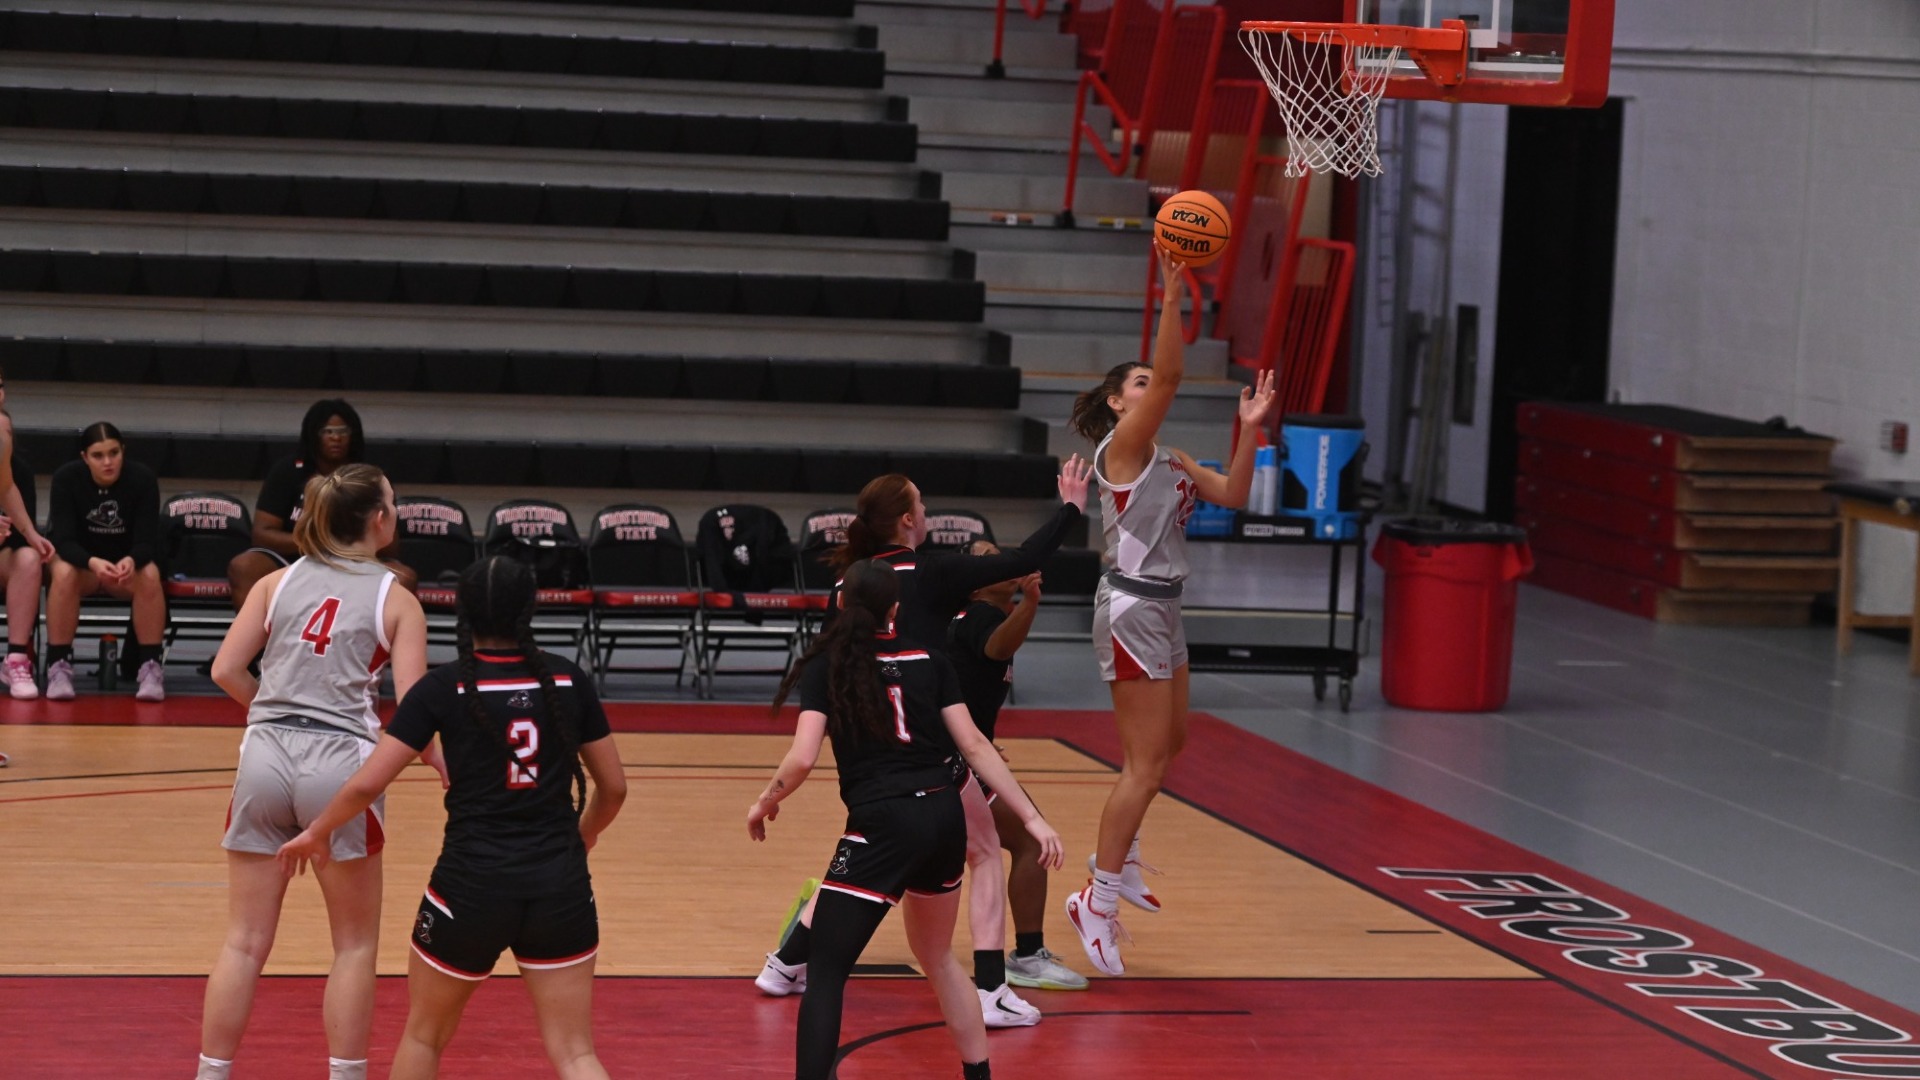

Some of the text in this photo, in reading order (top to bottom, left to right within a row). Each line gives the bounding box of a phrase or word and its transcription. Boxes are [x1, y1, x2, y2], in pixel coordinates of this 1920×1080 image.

[1171, 209, 1210, 228] NCAA
[1161, 228, 1210, 253] Wilson
[1315, 435, 1330, 510] POWERADE
[169, 498, 241, 519] FROSTBURG
[495, 505, 567, 526] FROSTBURG
[185, 514, 227, 529] STATE
[407, 519, 448, 535] STATE
[511, 522, 553, 537] STATE
[599, 510, 670, 531] FROSTBURG
[615, 526, 657, 540] STATE
[194, 585, 232, 595] BOBCA
[633, 594, 679, 605] BOBCATS
[299, 596, 342, 657] 4
[887, 684, 911, 742] 1
[506, 718, 539, 788] 2
